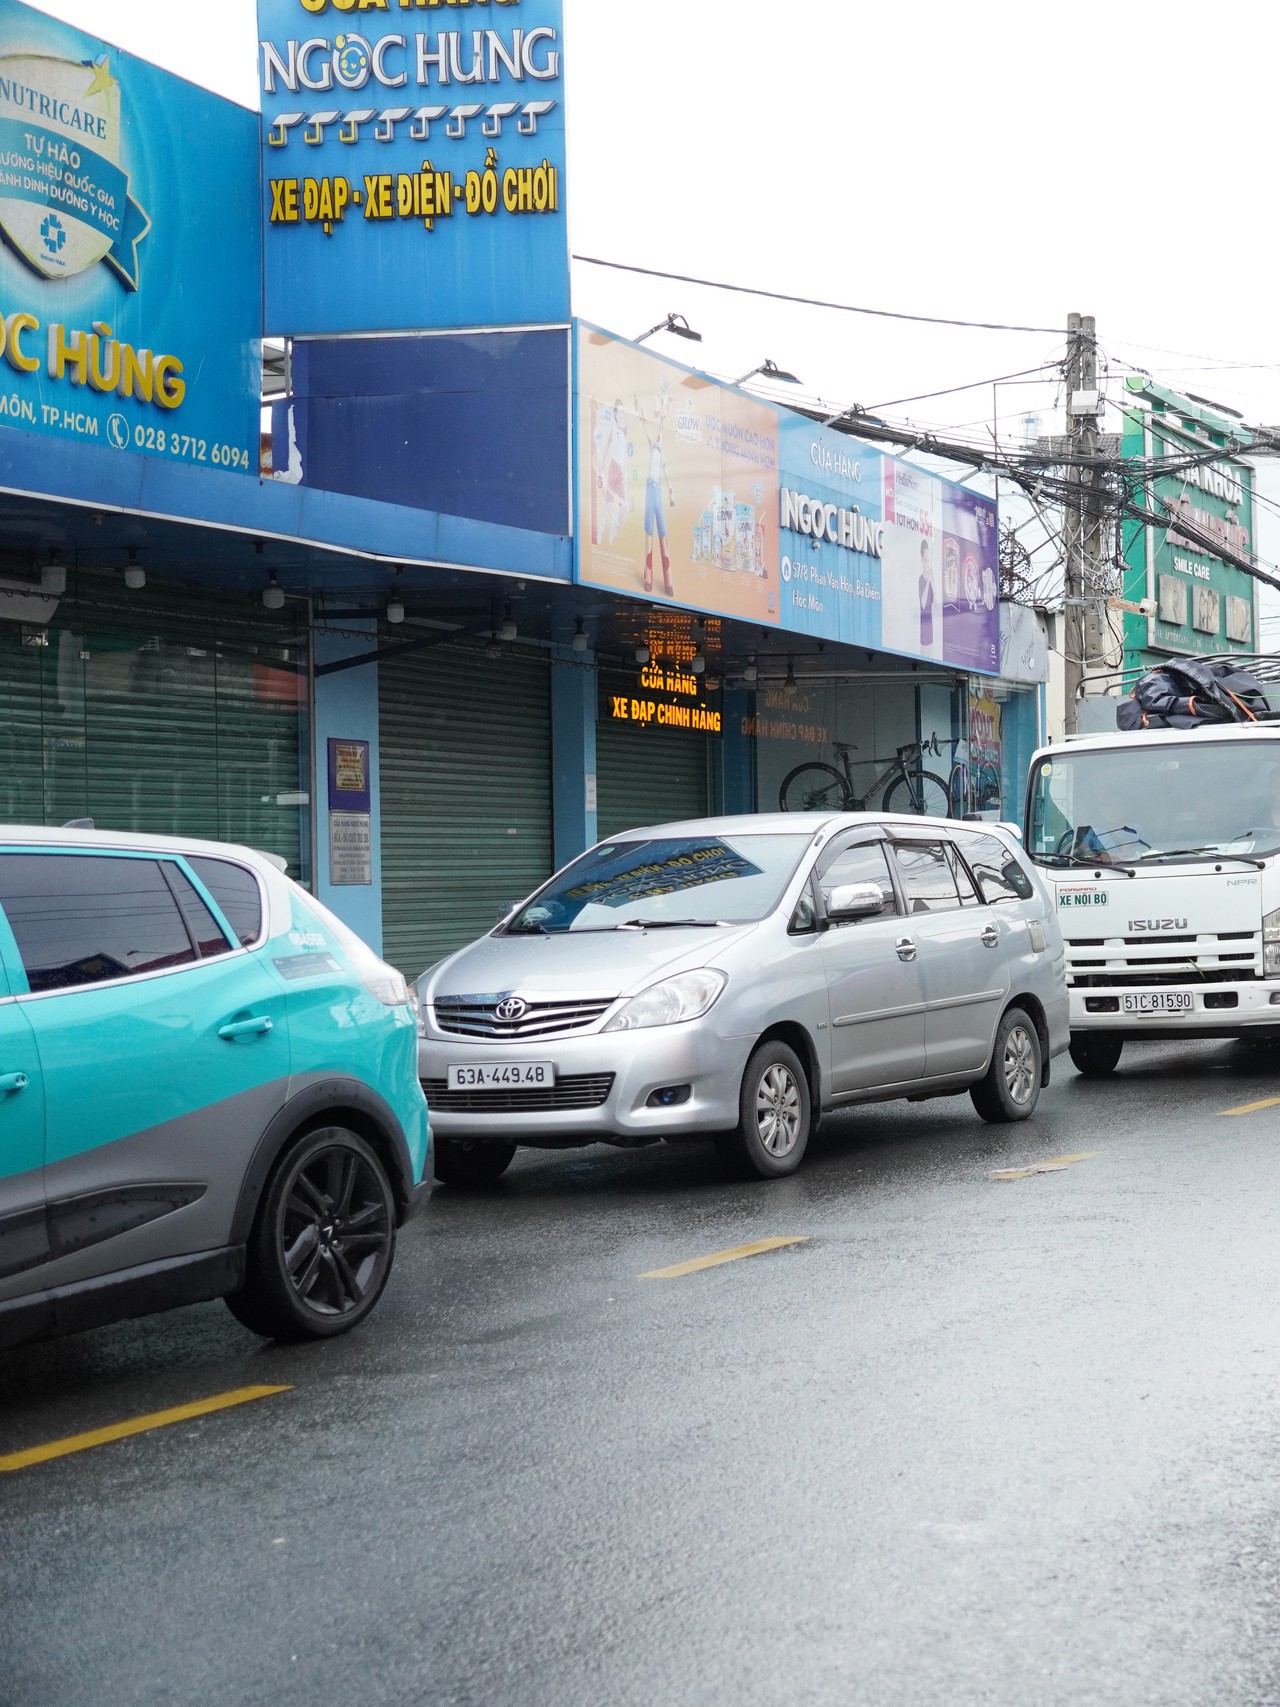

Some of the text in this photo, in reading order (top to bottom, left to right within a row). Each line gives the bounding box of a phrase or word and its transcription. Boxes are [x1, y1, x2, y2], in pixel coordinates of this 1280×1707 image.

[0, 76, 107, 141] NUTRICARE
[48, 142, 81, 169] HÀO
[24, 175, 49, 196] DINH
[90, 203, 99, 216] Y
[98, 207, 120, 232] HỌC
[97, 188, 115, 210] GIA
[269, 147, 558, 235] XE ĐẠP XE ĐIỆN ĐỒ CHƠI
[48, 320, 186, 409] HÙNG
[41, 404, 99, 436] TP.HCM
[134, 425, 166, 451] 028
[170, 433, 207, 461] 3712
[211, 443, 250, 470] 6094
[780, 487, 838, 550] NGỌC
[1173, 556, 1210, 581] SMILE CARE
[613, 696, 721, 732] XE ĐẠP CHÍNH HÃNG
[1060, 895, 1072, 906] XE
[1075, 892, 1091, 907] NỘI
[1227, 879, 1258, 887] NPR
[1128, 918, 1188, 932] ISUZU
